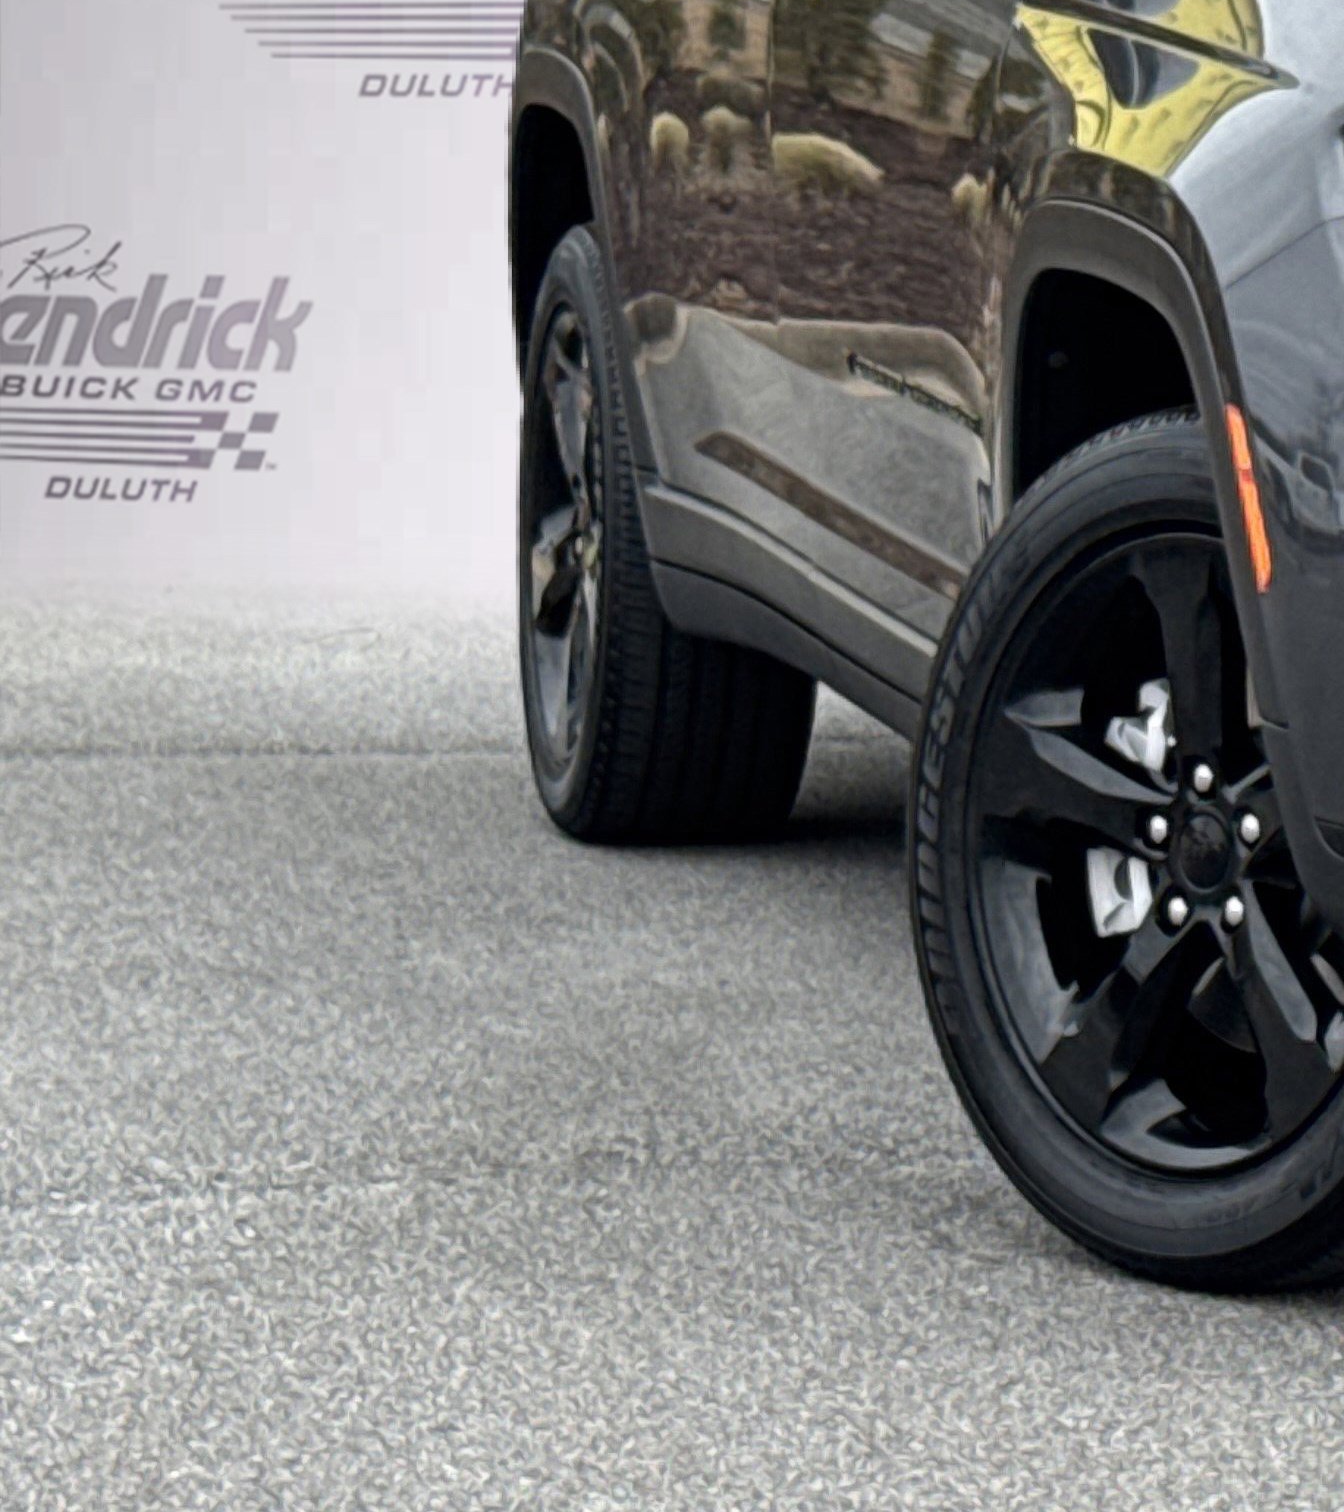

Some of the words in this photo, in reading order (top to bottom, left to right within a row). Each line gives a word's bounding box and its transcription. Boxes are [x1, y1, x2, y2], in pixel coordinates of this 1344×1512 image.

[0, 273, 314, 373] endrick
[0, 373, 140, 402] BUICK
[154, 377, 257, 404] GMC
[44, 475, 198, 503] DULUTH
